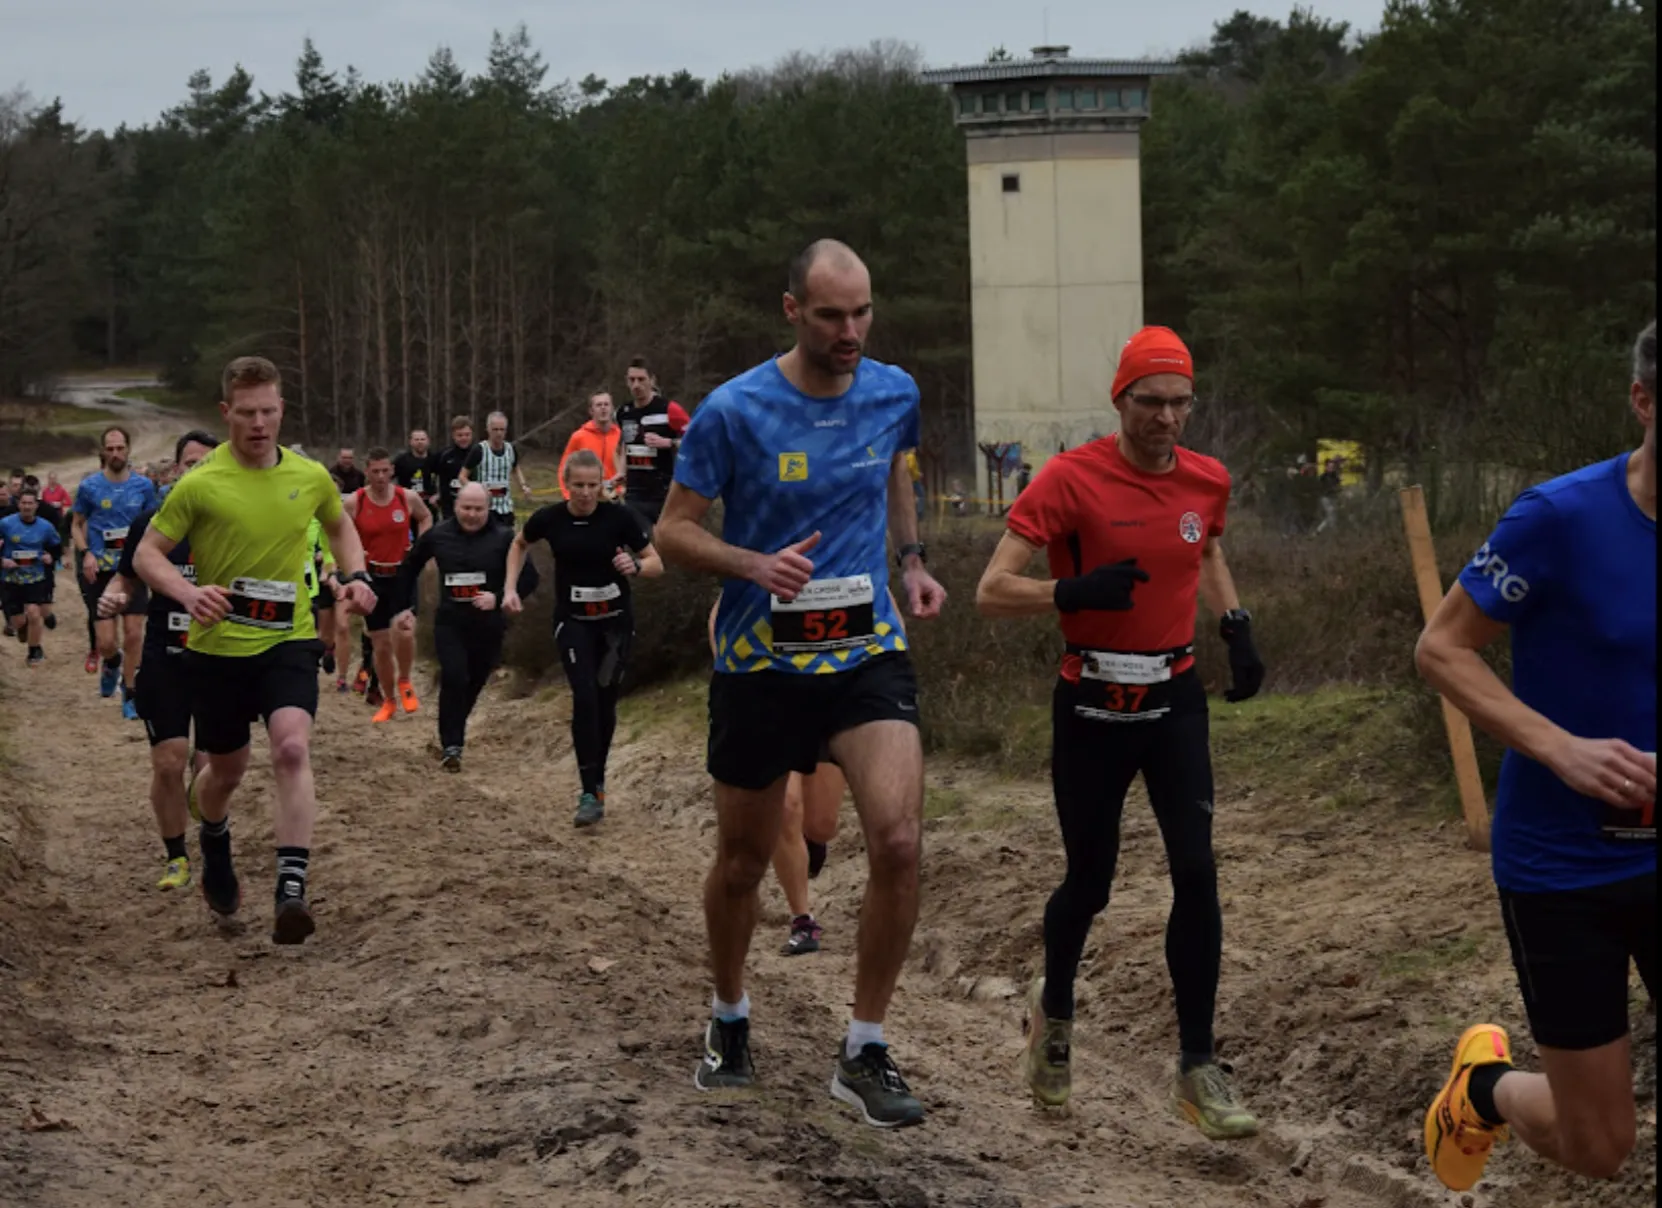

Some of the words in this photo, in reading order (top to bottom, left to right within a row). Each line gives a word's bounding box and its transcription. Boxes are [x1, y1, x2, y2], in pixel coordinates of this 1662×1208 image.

[1472, 541, 1530, 602] ORG
[247, 599, 277, 621] 15
[803, 609, 849, 641] 52
[1104, 684, 1149, 712] 37
